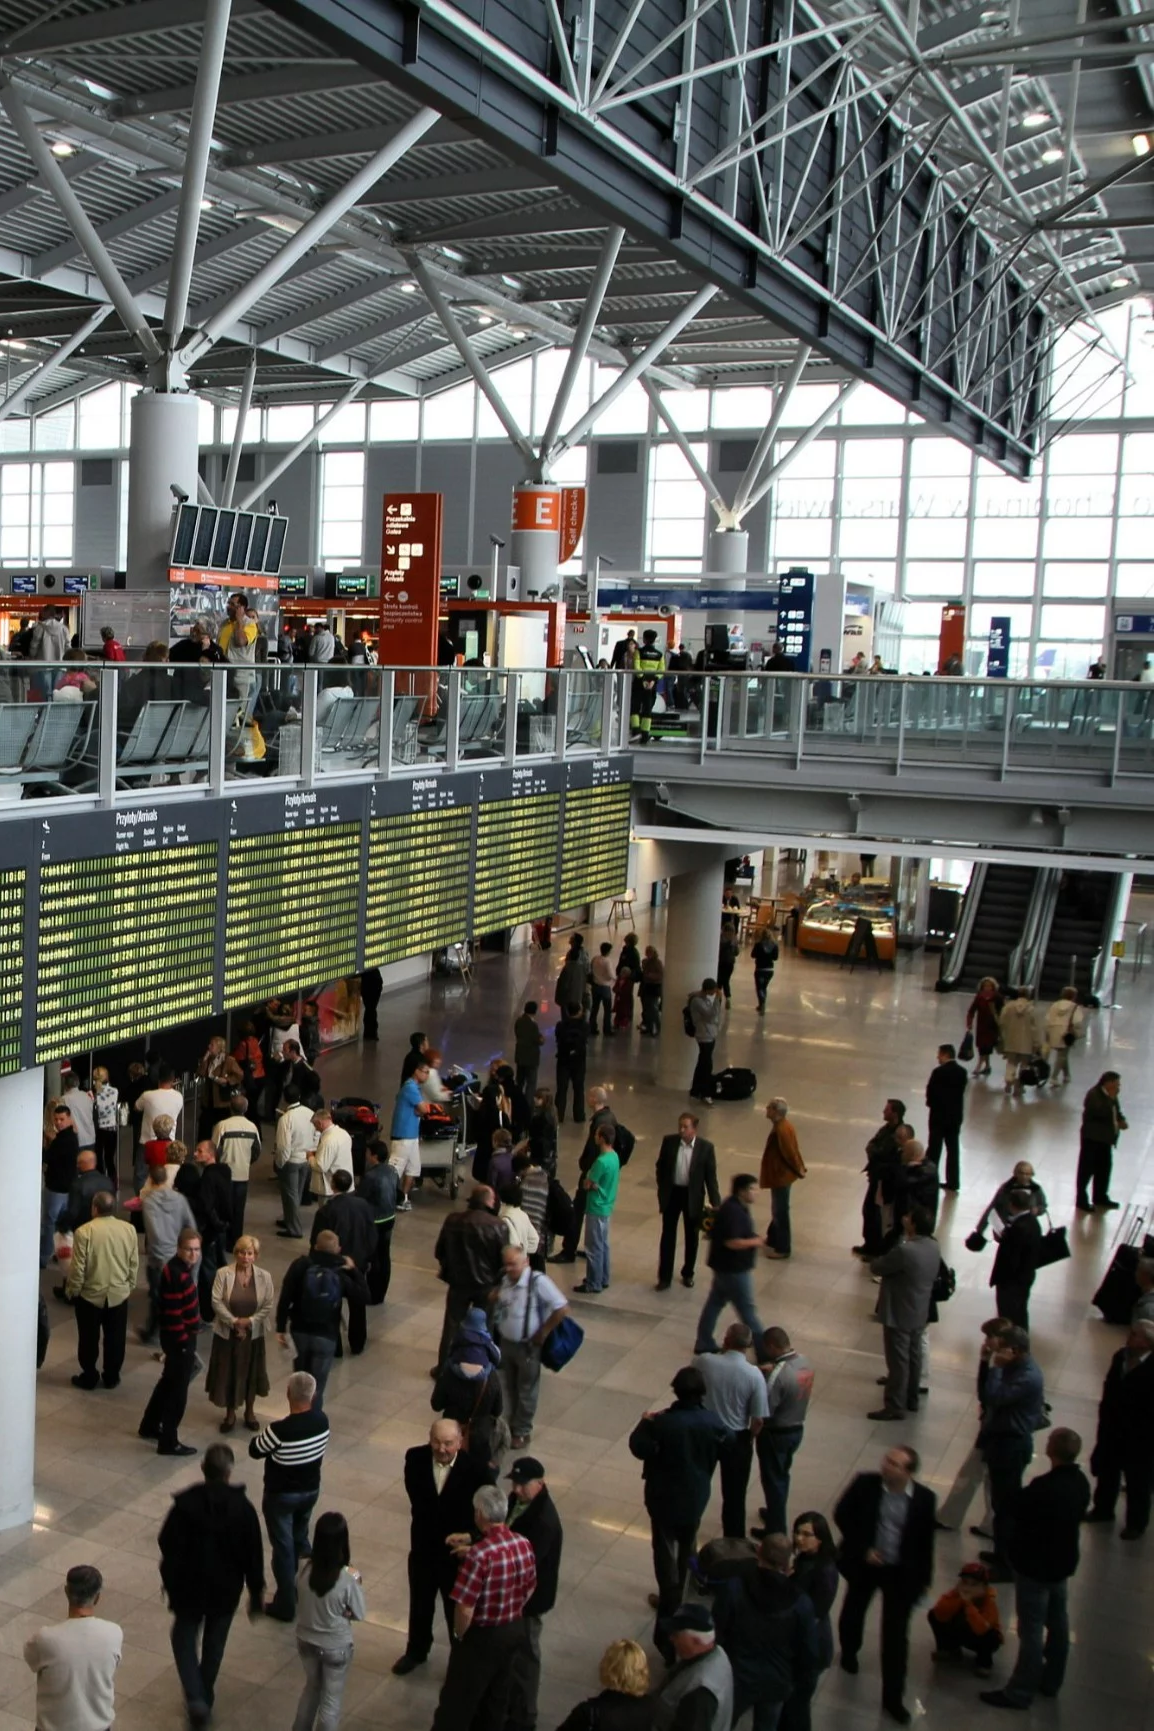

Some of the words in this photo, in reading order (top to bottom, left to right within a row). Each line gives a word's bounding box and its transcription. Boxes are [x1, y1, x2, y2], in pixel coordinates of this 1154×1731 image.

[535, 498, 553, 524] E
[570, 489, 579, 522] check-in
[569, 524, 577, 545] Self
